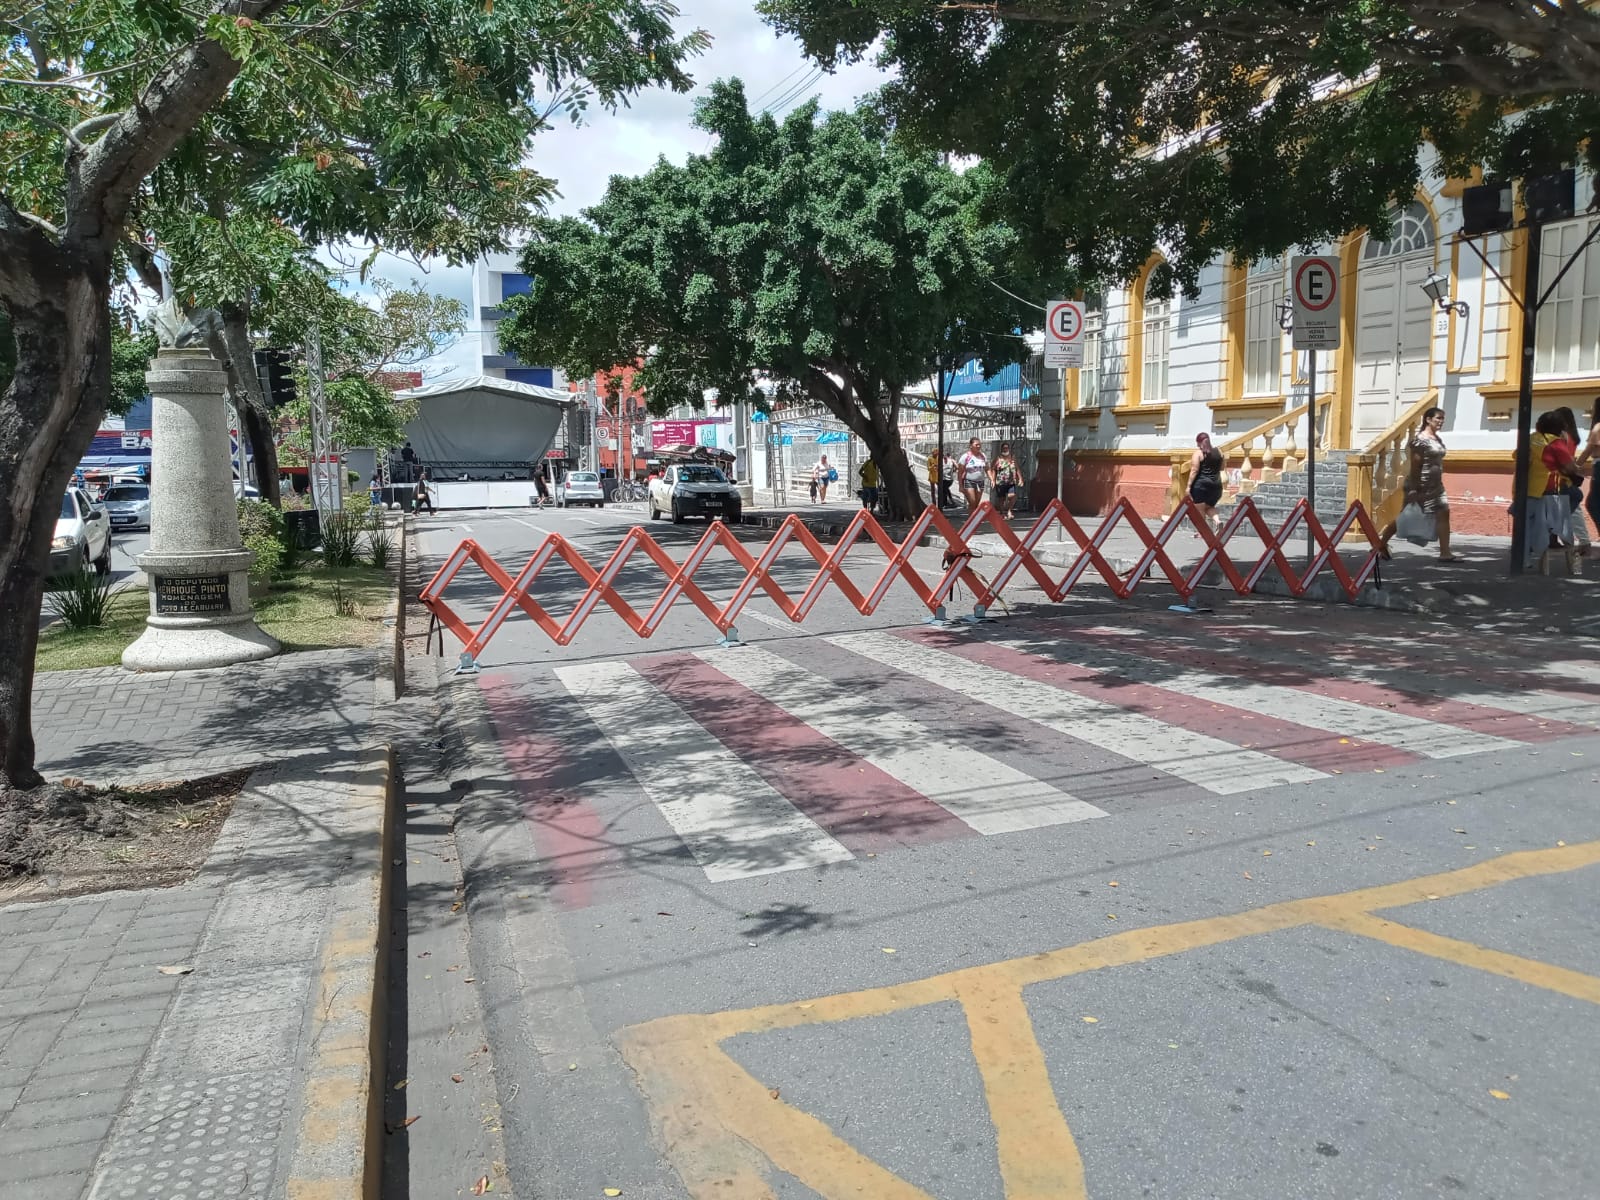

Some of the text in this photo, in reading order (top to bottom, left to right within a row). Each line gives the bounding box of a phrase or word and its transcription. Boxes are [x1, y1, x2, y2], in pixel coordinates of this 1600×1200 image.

[1309, 271, 1323, 299] E
[1061, 312, 1072, 332] E
[157, 584, 226, 595] HENRIQUE PINTO
